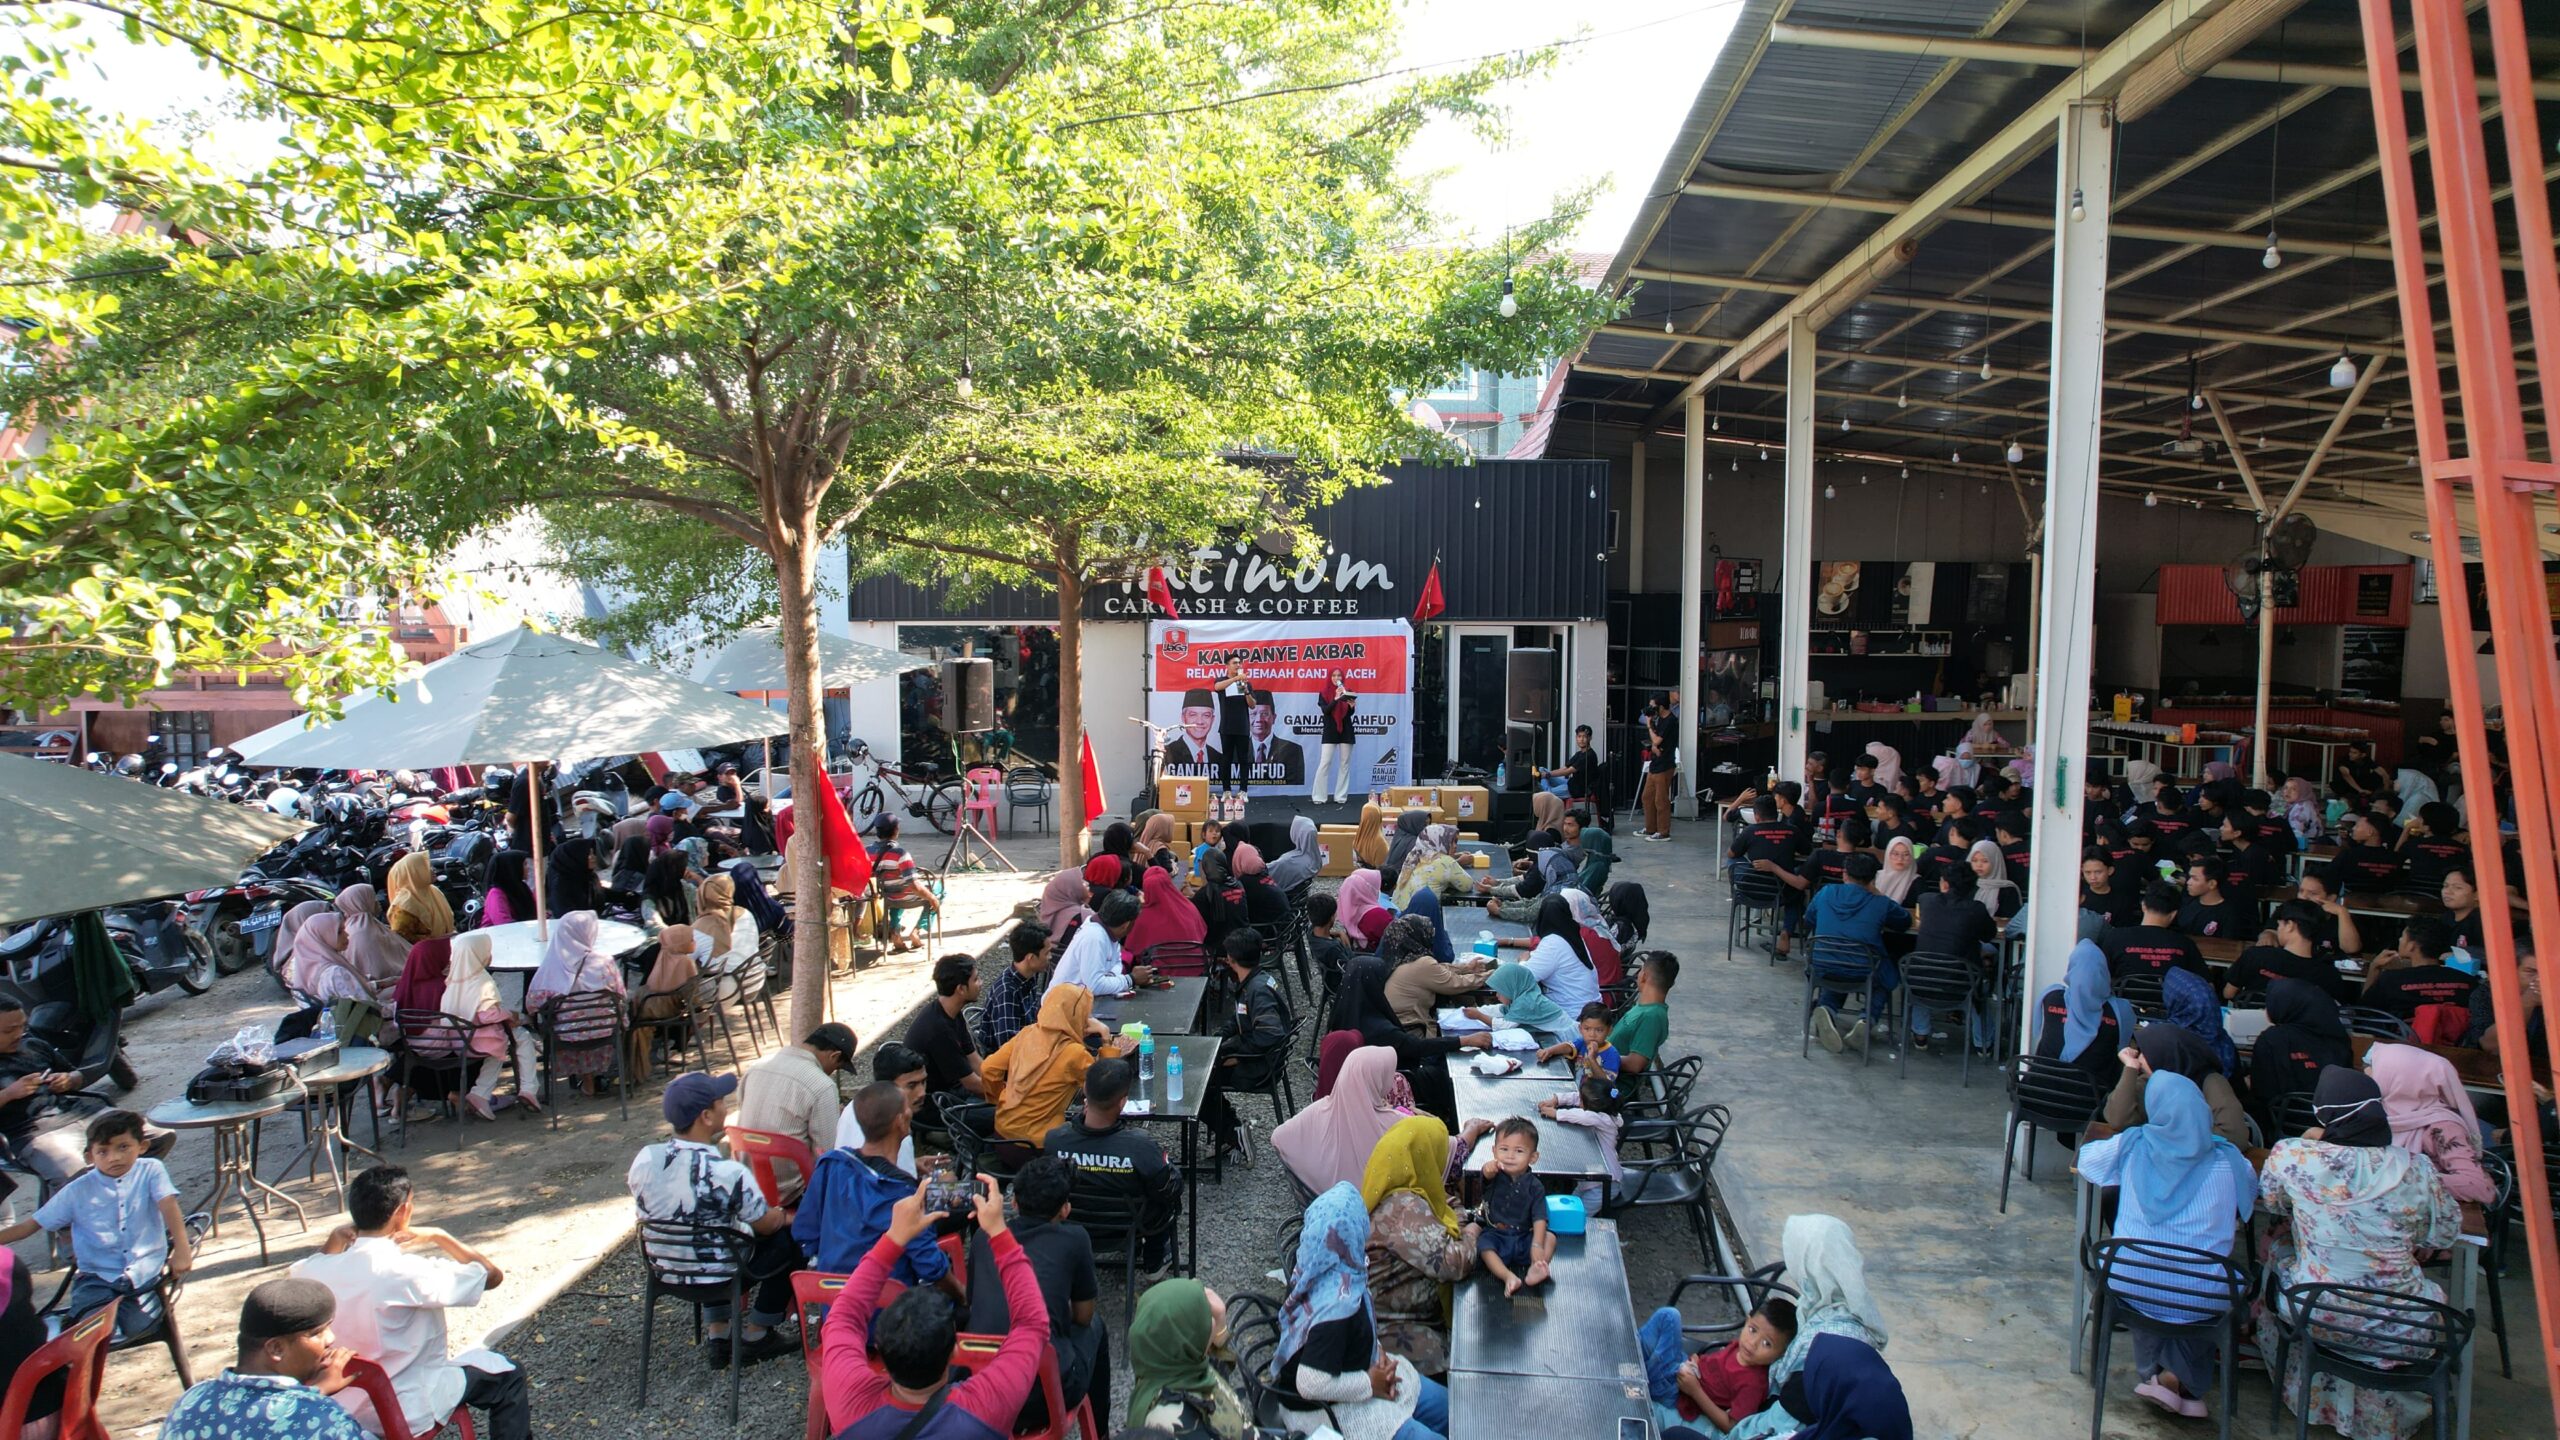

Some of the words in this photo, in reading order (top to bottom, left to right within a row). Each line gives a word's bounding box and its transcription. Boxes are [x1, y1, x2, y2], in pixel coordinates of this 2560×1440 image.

[1235, 597, 1252, 614] &
[1259, 598, 1359, 614] COFFEE
[1302, 643, 1365, 661] AKBAR
[1187, 668, 1228, 678] RELAW
[1247, 668, 1294, 679] JEMAAH
[1297, 668, 1328, 679] GANJ
[1345, 668, 1377, 679] ACEH
[1284, 715, 1324, 725] GANJA
[1352, 715, 1396, 725] AHFUD
[1372, 767, 1397, 775] GANJAR
[1371, 774, 1395, 782] MAHFUD
